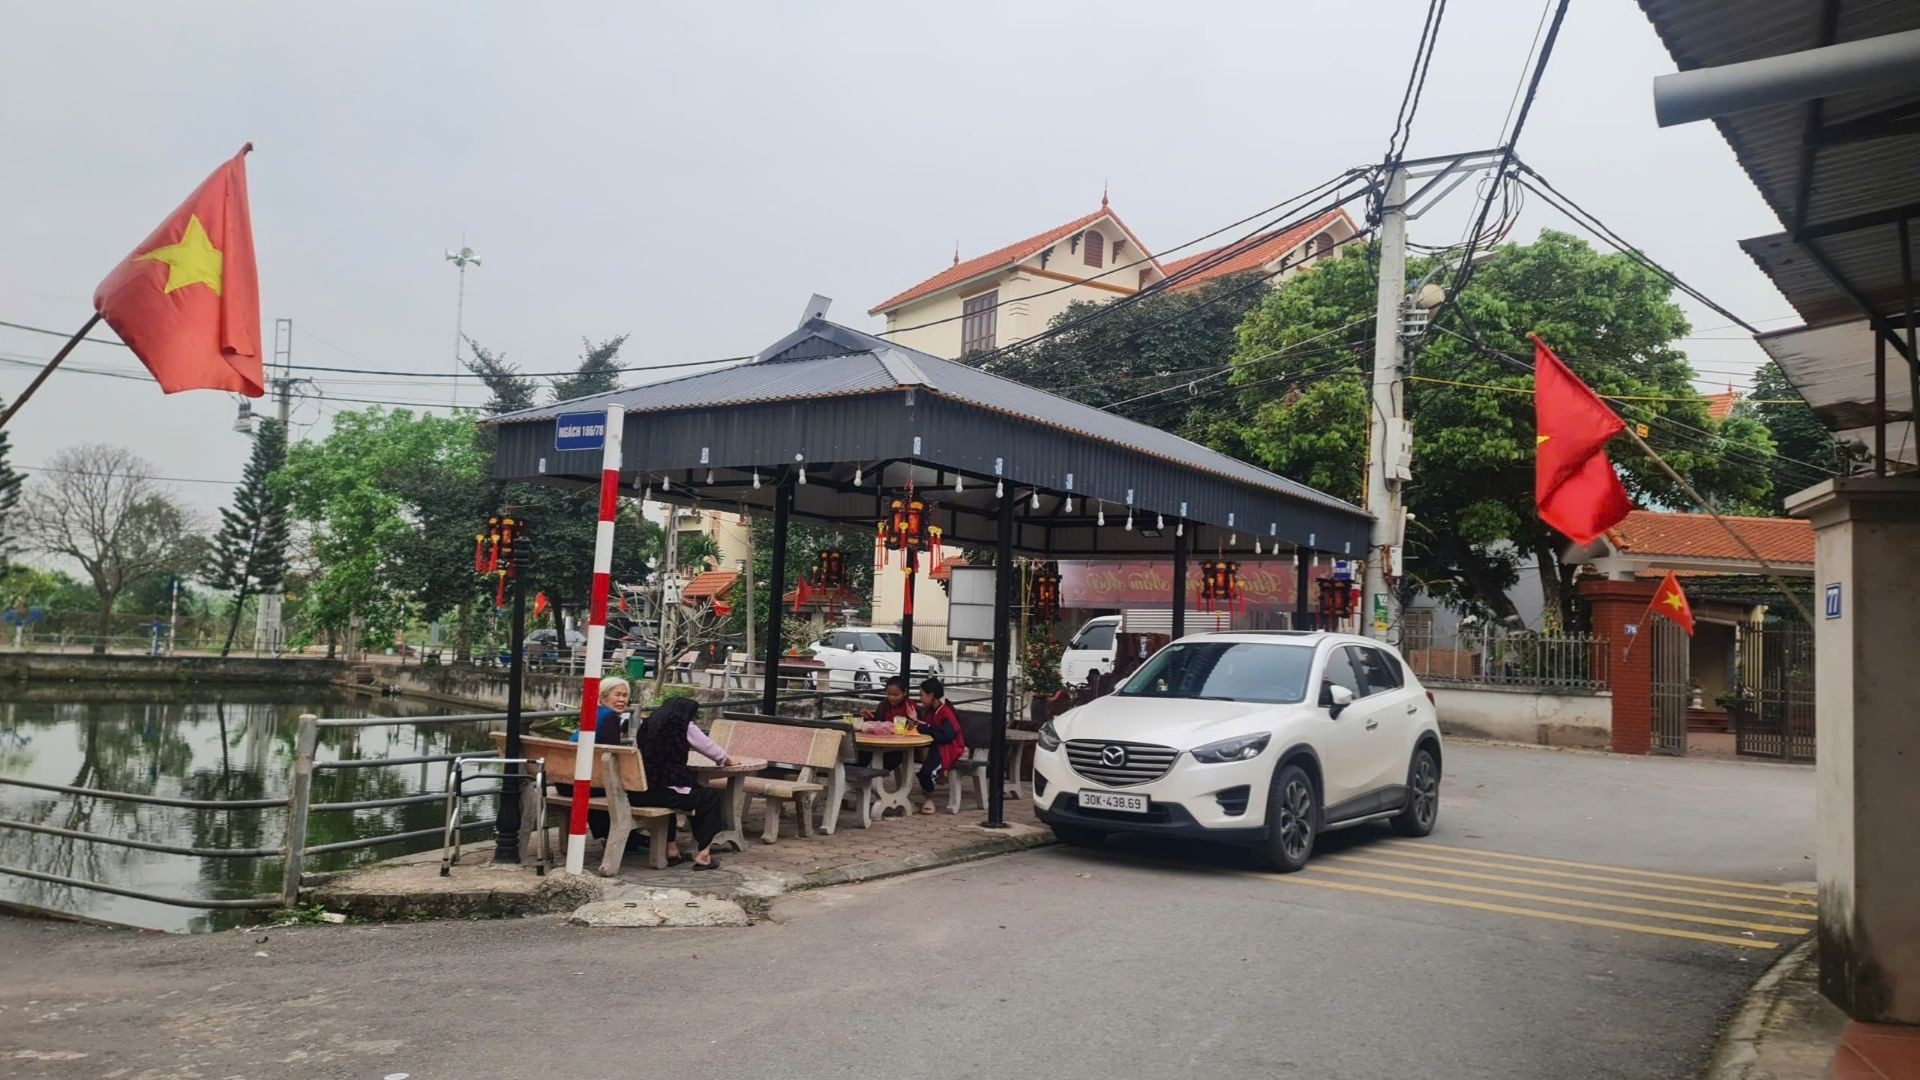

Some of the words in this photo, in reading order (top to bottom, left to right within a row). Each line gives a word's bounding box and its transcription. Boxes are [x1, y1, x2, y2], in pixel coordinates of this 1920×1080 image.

[558, 424, 581, 438] NGÁCH
[1827, 588, 1838, 614] 77
[1084, 794, 1141, 809] 30K-438.69
